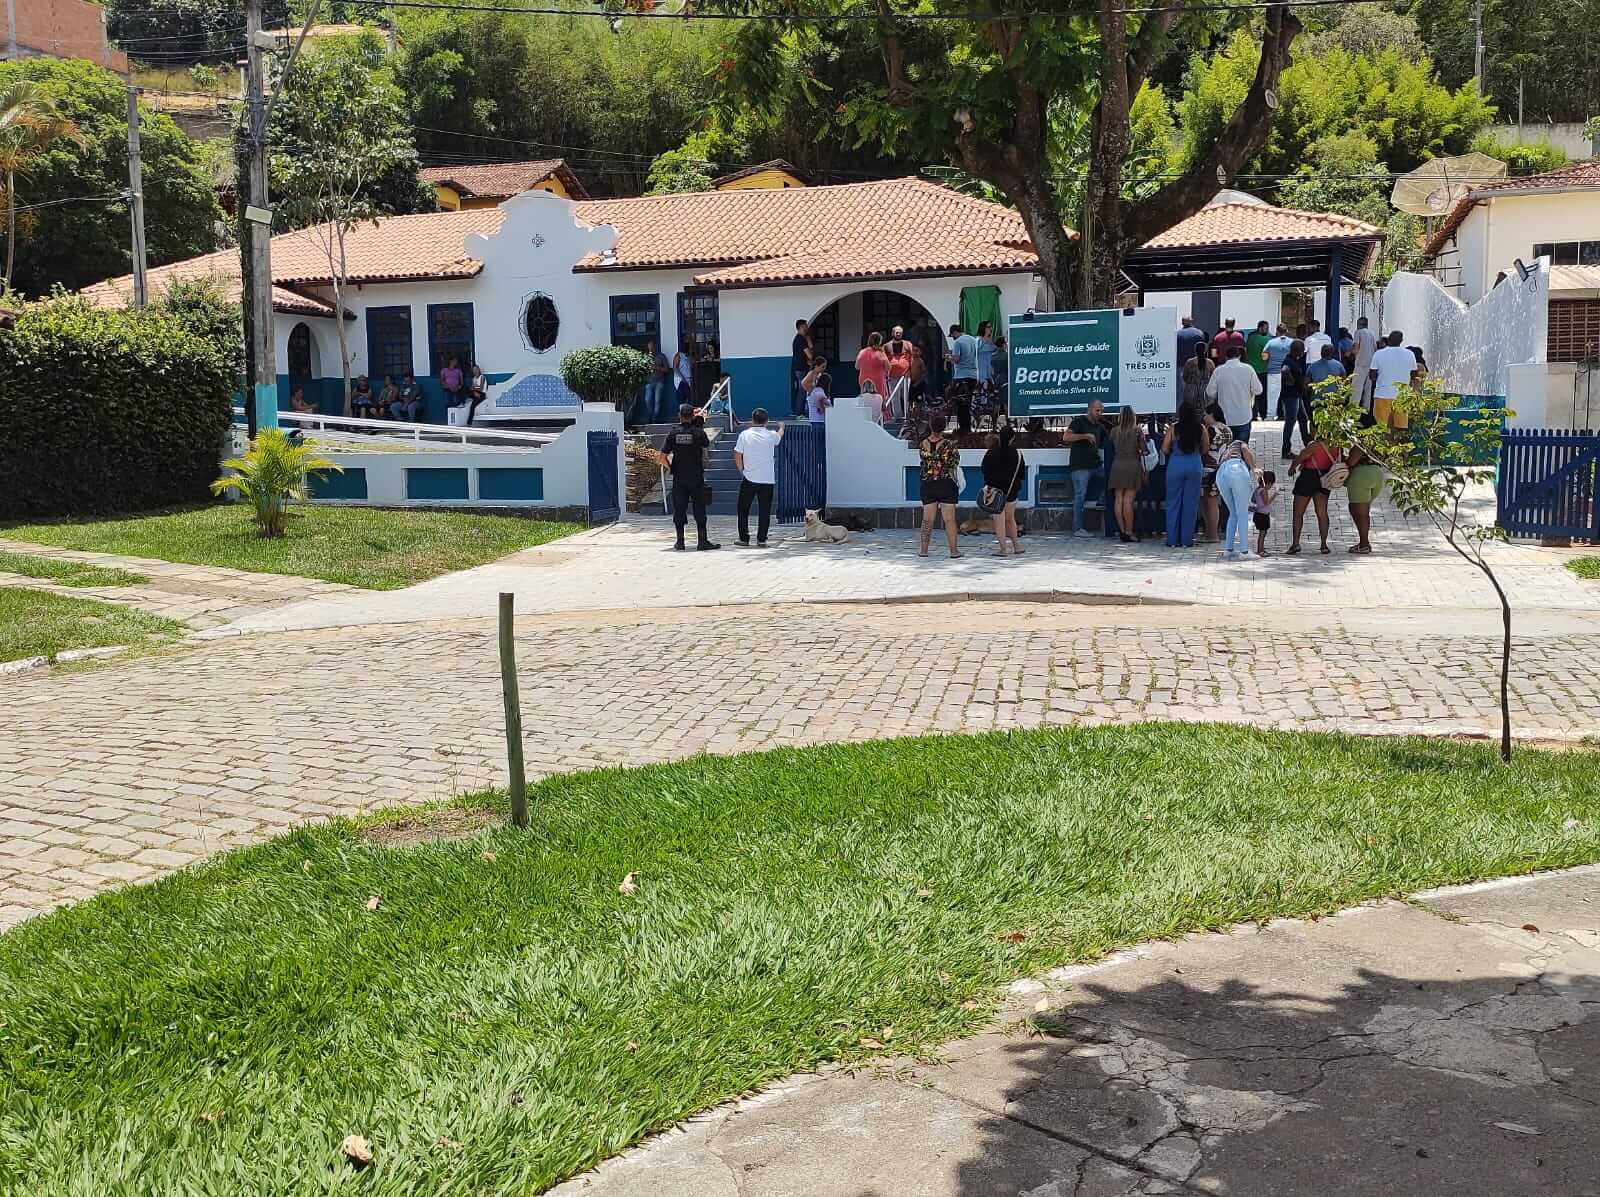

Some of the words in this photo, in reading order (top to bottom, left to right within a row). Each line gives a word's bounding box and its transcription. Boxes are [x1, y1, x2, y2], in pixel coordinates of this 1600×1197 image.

[1015, 346, 1046, 355] Unidade
[1048, 344, 1072, 353] Básica
[1074, 344, 1084, 352] de
[1086, 342, 1110, 352] Saúde
[1126, 362, 1146, 370] TRÊS
[1015, 365, 1112, 386] Bemposta
